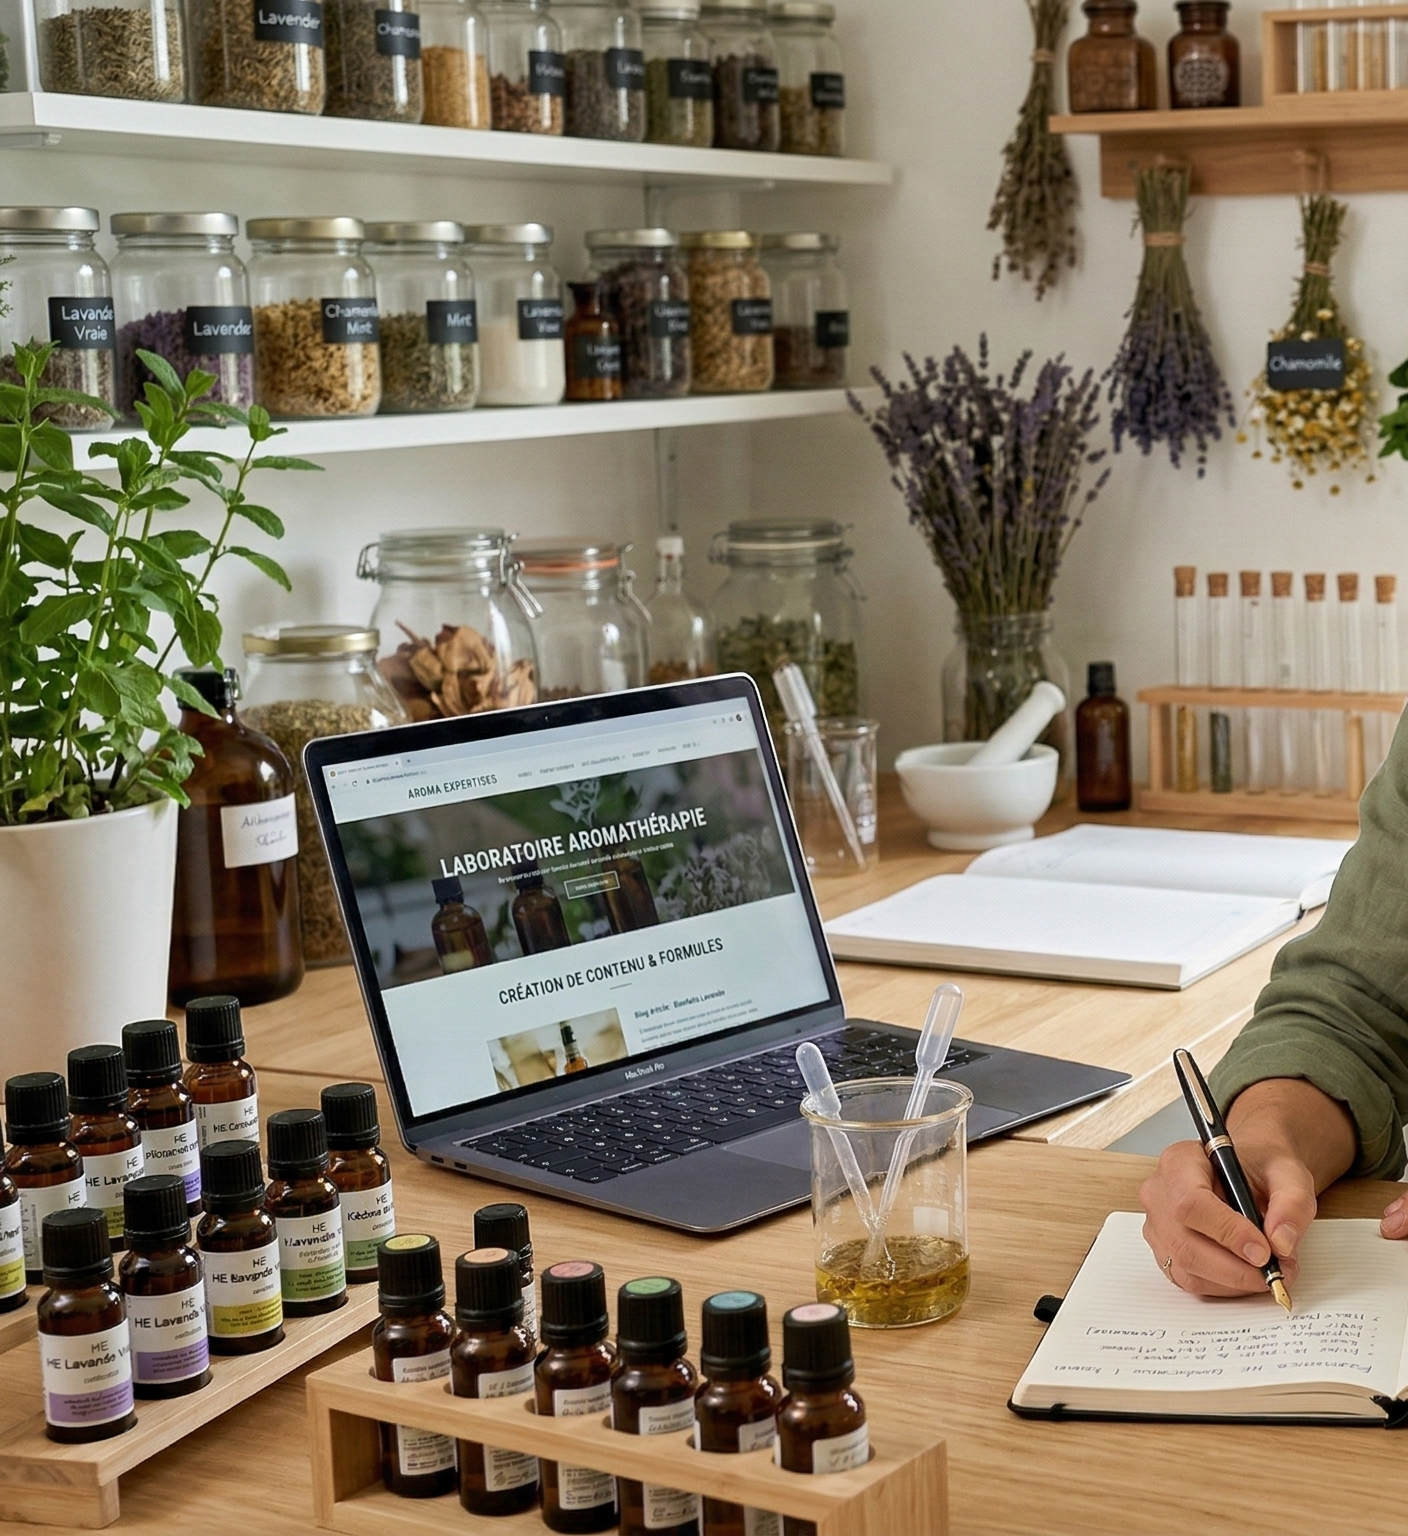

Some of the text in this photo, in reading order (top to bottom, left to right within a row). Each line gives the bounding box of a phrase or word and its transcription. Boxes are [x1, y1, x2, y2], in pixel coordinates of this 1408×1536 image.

[74, 325, 108, 341] Vraie
[1269, 353, 1342, 373] Chamomile
[407, 783, 442, 800] AROMA
[443, 774, 498, 793] EXPERTISES
[440, 834, 562, 879] LABORATOIRE
[568, 806, 707, 852] AROMATHÉRAPIE
[499, 937, 724, 1005] CRÉATION DE CONTENU & FORMULES
[85, 1177, 100, 1188] HE
[312, 1222, 327, 1234] HE
[252, 1256, 266, 1269] HE
[212, 1273, 227, 1284] HE
[181, 1297, 195, 1310] HE
[135, 1315, 151, 1329] HE
[91, 1340, 109, 1354] HE
